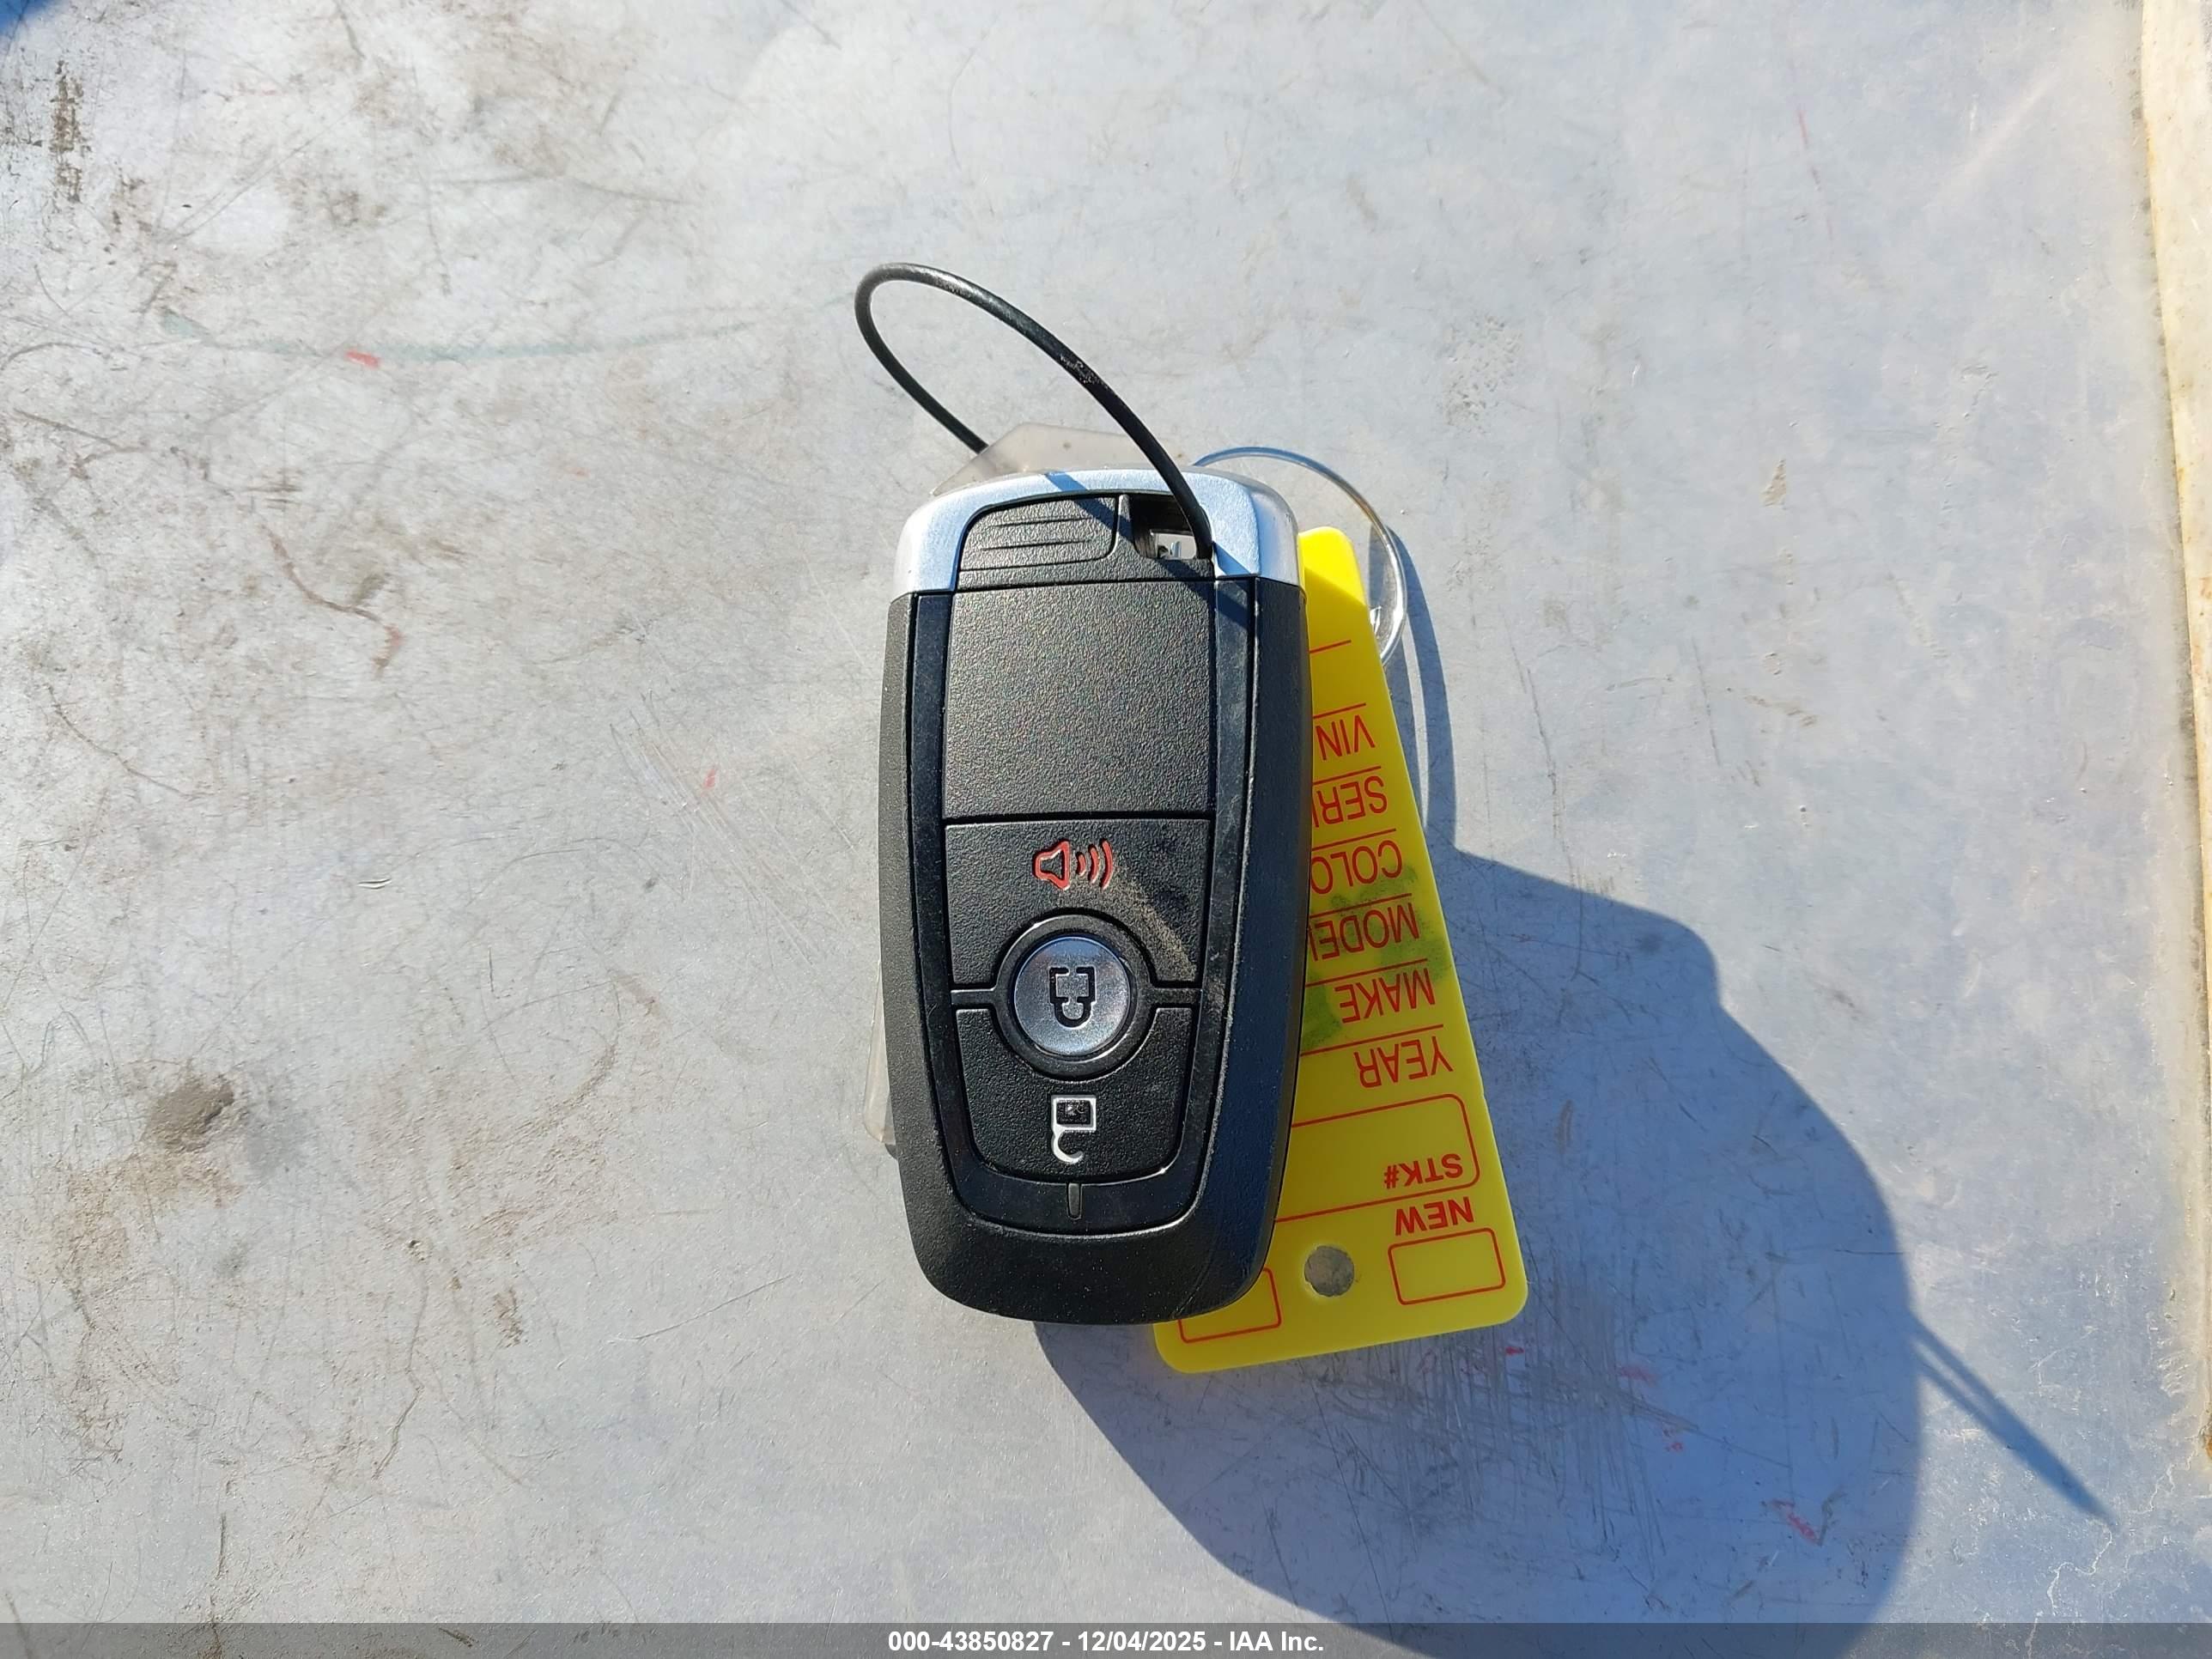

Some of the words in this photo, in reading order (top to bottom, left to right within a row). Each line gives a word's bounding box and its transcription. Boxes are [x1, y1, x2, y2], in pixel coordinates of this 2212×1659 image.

[1316, 714, 1376, 761] VIN
[1310, 840, 1402, 895] COLO
[1334, 968, 1436, 1024] MAKE
[1353, 1036, 1454, 1088] YEAR
[1383, 1153, 1463, 1189] STK#
[1395, 1196, 1474, 1237] NEW
